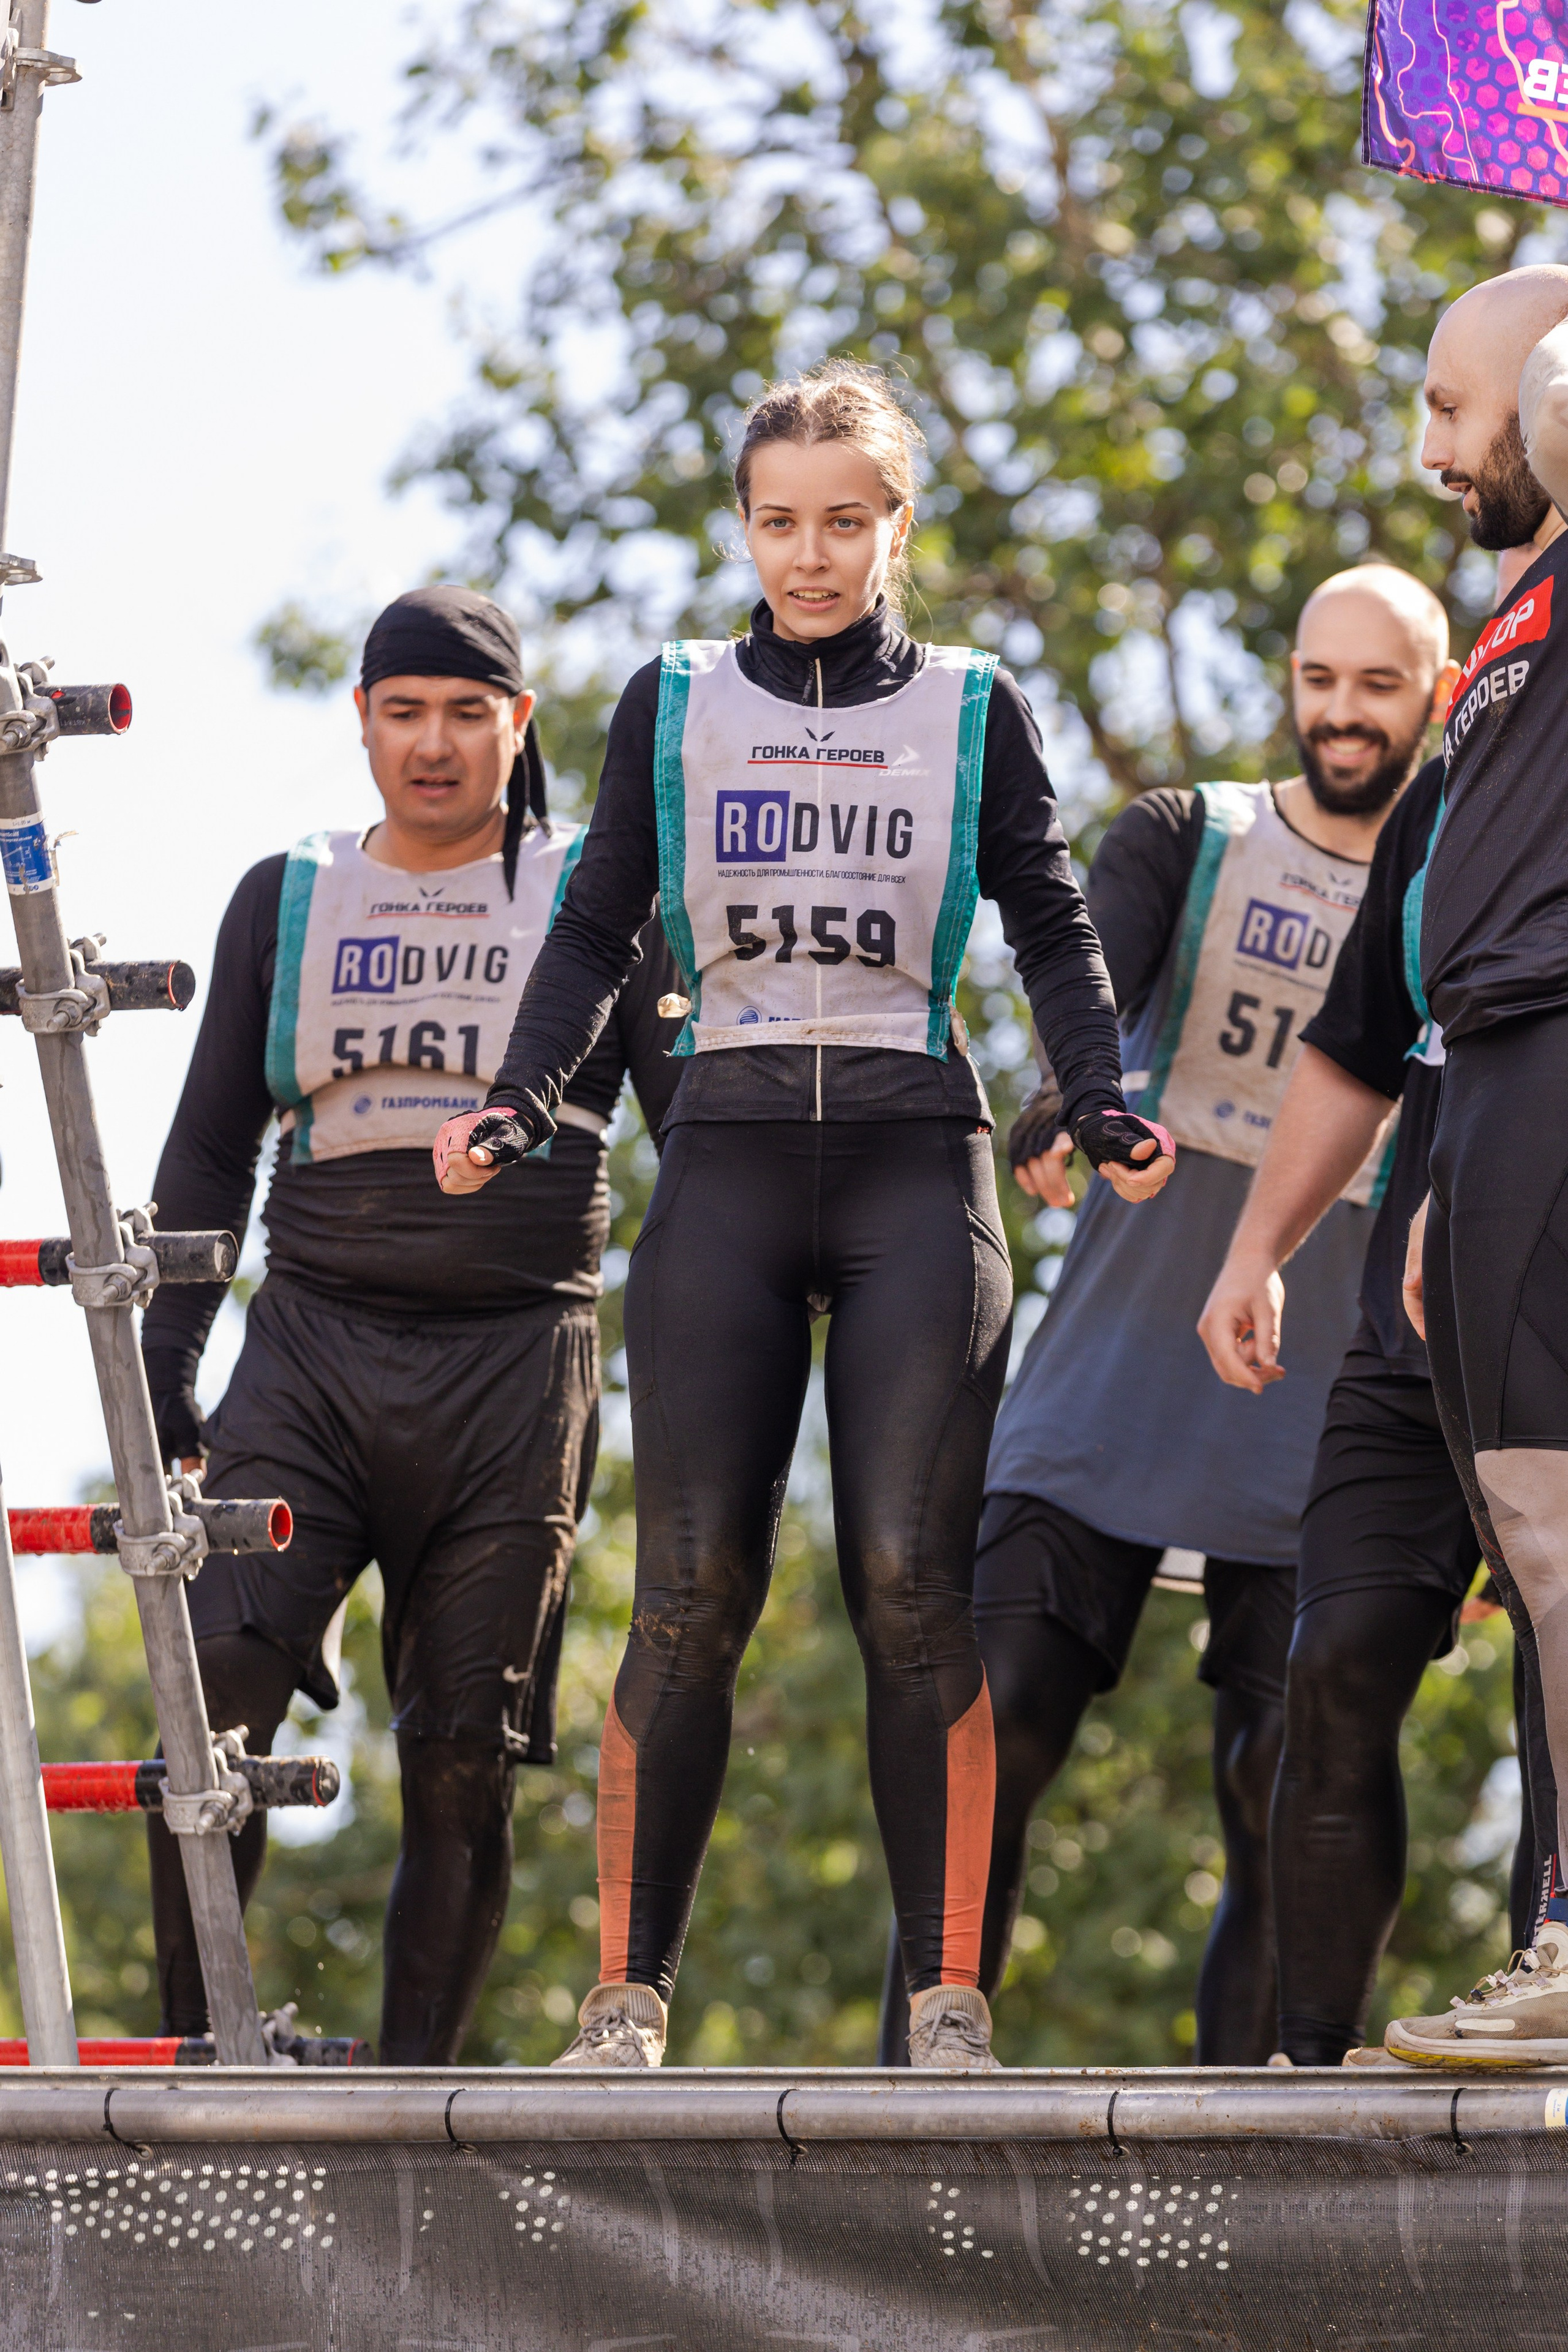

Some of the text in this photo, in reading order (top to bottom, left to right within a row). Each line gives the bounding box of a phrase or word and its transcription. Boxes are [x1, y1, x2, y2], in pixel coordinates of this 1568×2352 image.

[1455, 660, 1530, 747] ГЕРОЕВ
[752, 745, 884, 763] ГОНКА ГЕРОЕВ
[878, 767, 932, 777] DEMIX
[722, 801, 913, 859] RODVIG
[718, 869, 907, 883] НАДЕЖНОСТЬ ДЛЯ ПРОМЫШЛЕННОСТИ, БЛАГОСОСТОЯНИЕ ДЛЯ ВСЕХ
[370, 902, 488, 914] ГОНКА ГЕРОЕВ
[726, 905, 896, 968] 5159
[337, 943, 509, 987] RODVIG
[331, 1020, 480, 1079] 5161
[382, 1096, 479, 1109] ГАЗПРОМБАНК
